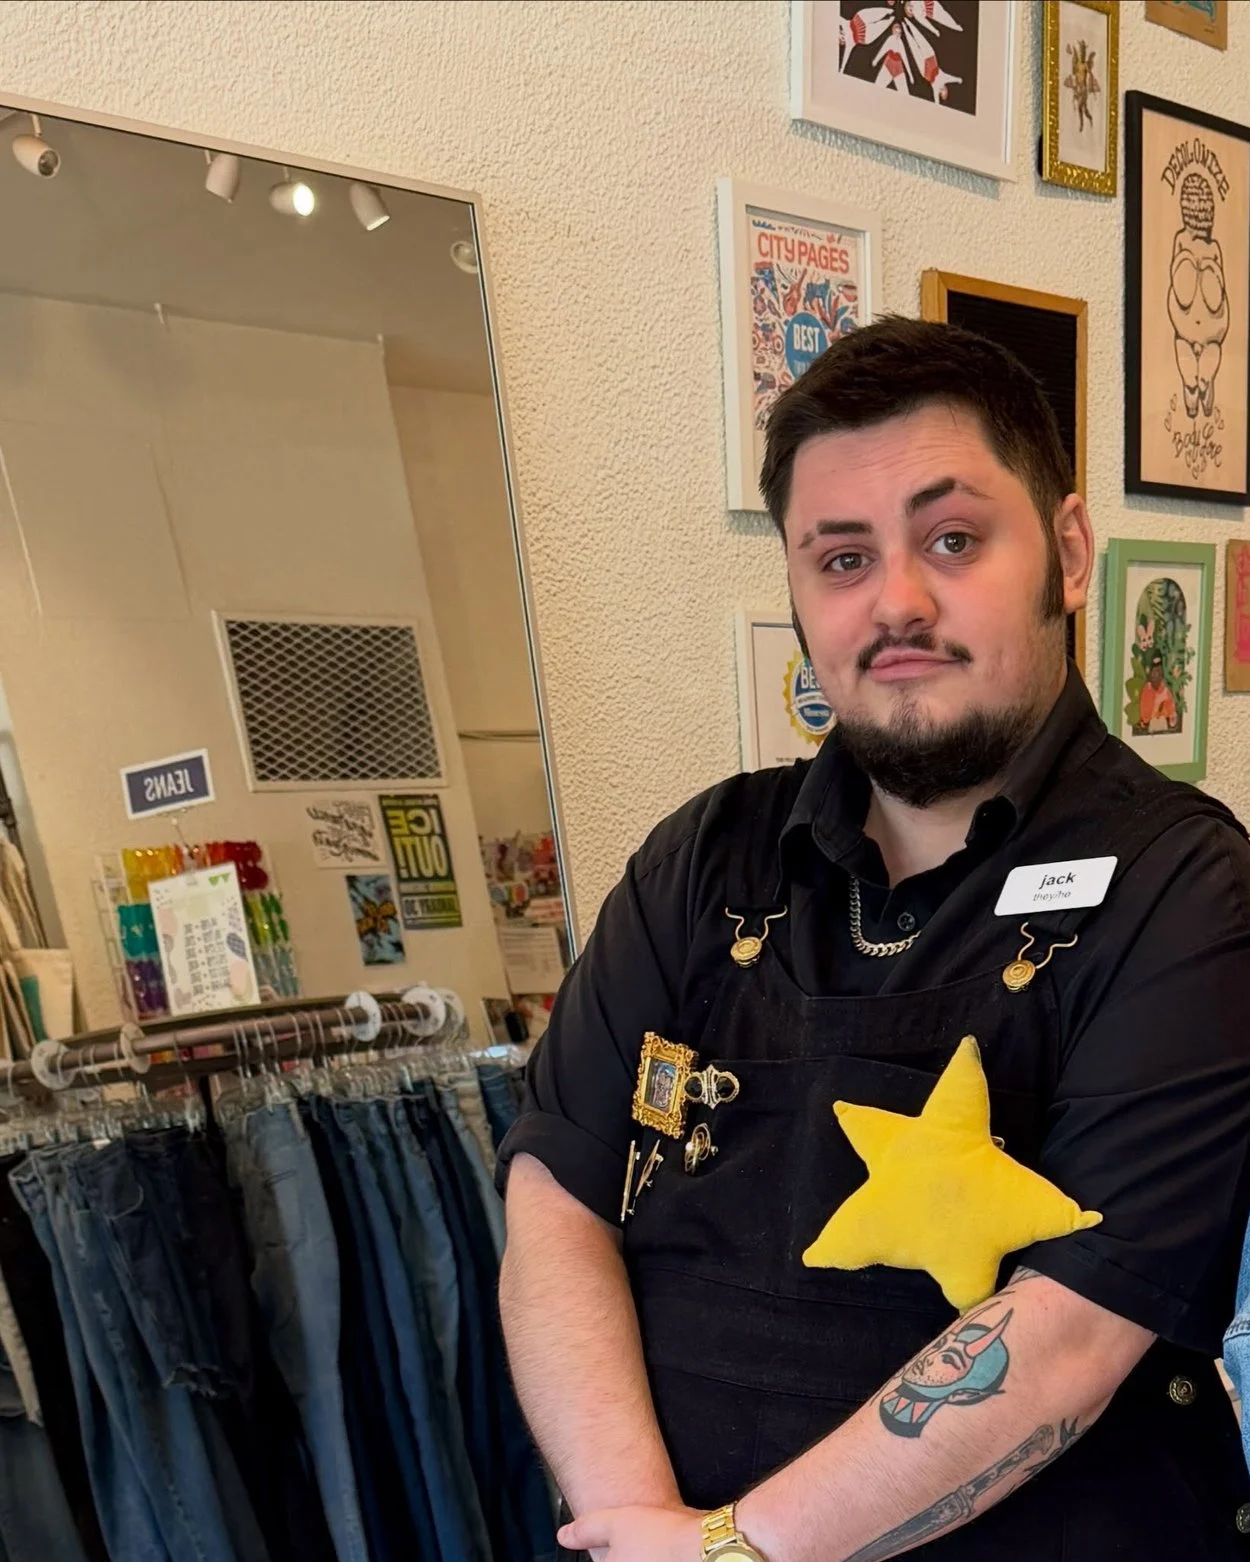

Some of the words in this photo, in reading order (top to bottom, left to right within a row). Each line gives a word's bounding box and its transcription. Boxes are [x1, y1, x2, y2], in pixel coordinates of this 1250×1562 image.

[1160, 138, 1230, 201] DECOLONIZE
[758, 231, 795, 263] CITY
[800, 241, 849, 275] PAGES
[793, 323, 820, 353] BEST
[1039, 871, 1076, 889] jack
